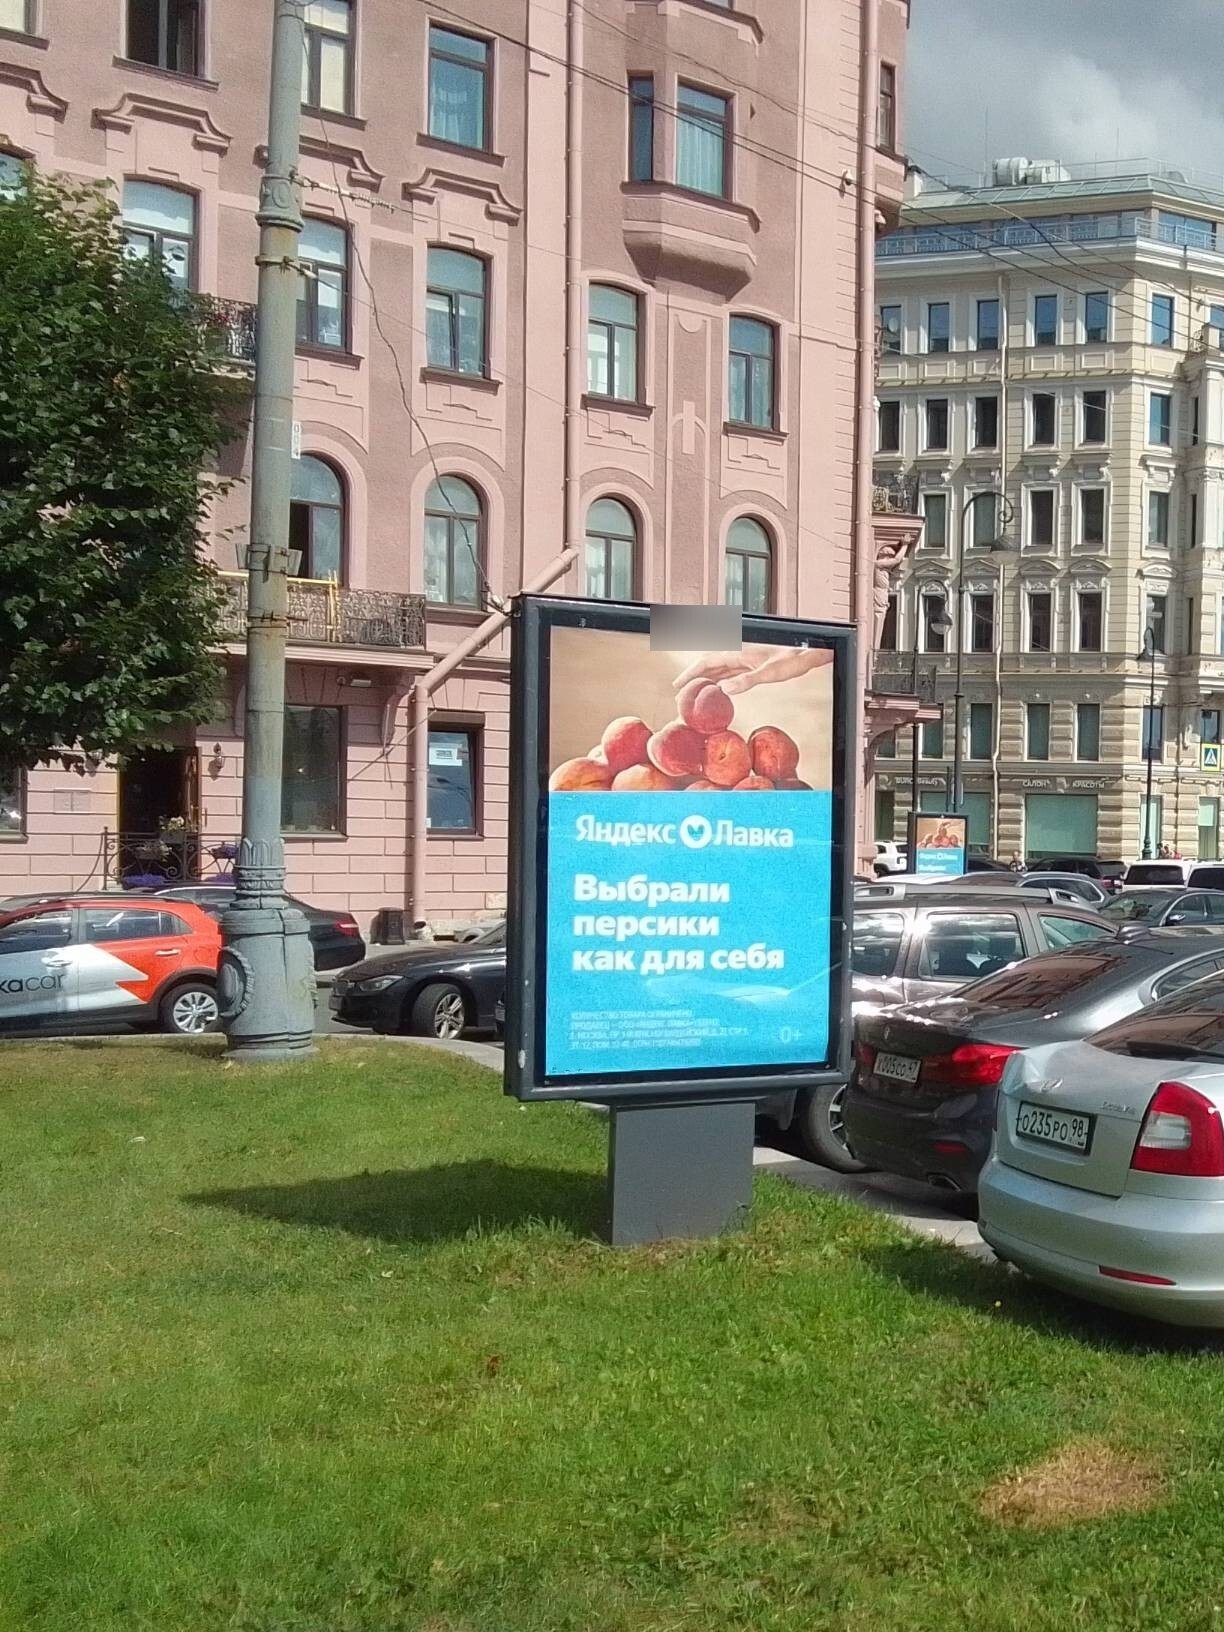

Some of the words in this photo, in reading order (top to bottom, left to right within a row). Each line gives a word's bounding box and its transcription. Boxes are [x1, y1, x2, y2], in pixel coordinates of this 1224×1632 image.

[575, 814, 677, 846] Яндекс
[711, 819, 794, 848] Лавка
[572, 873, 731, 908] Выбрали
[572, 913, 720, 942] персики
[571, 948, 636, 972] как
[640, 947, 705, 976] для
[710, 942, 785, 970] себя
